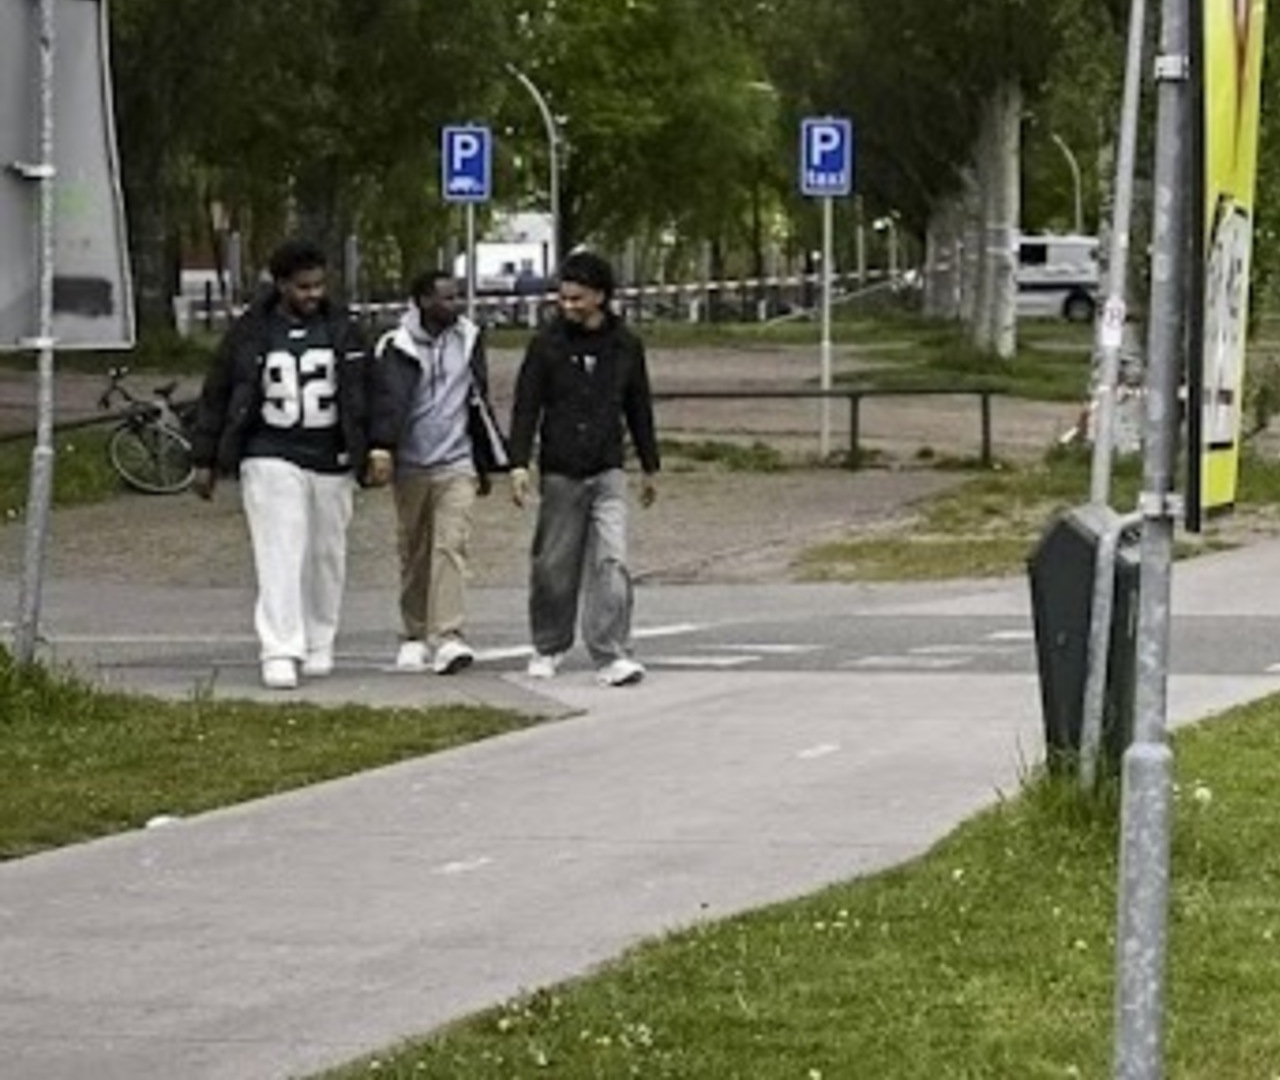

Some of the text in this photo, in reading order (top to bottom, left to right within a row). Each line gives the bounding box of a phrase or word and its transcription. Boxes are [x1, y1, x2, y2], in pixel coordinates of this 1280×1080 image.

[453, 134, 480, 170] P
[812, 126, 840, 166] P
[262, 348, 337, 428] 92
